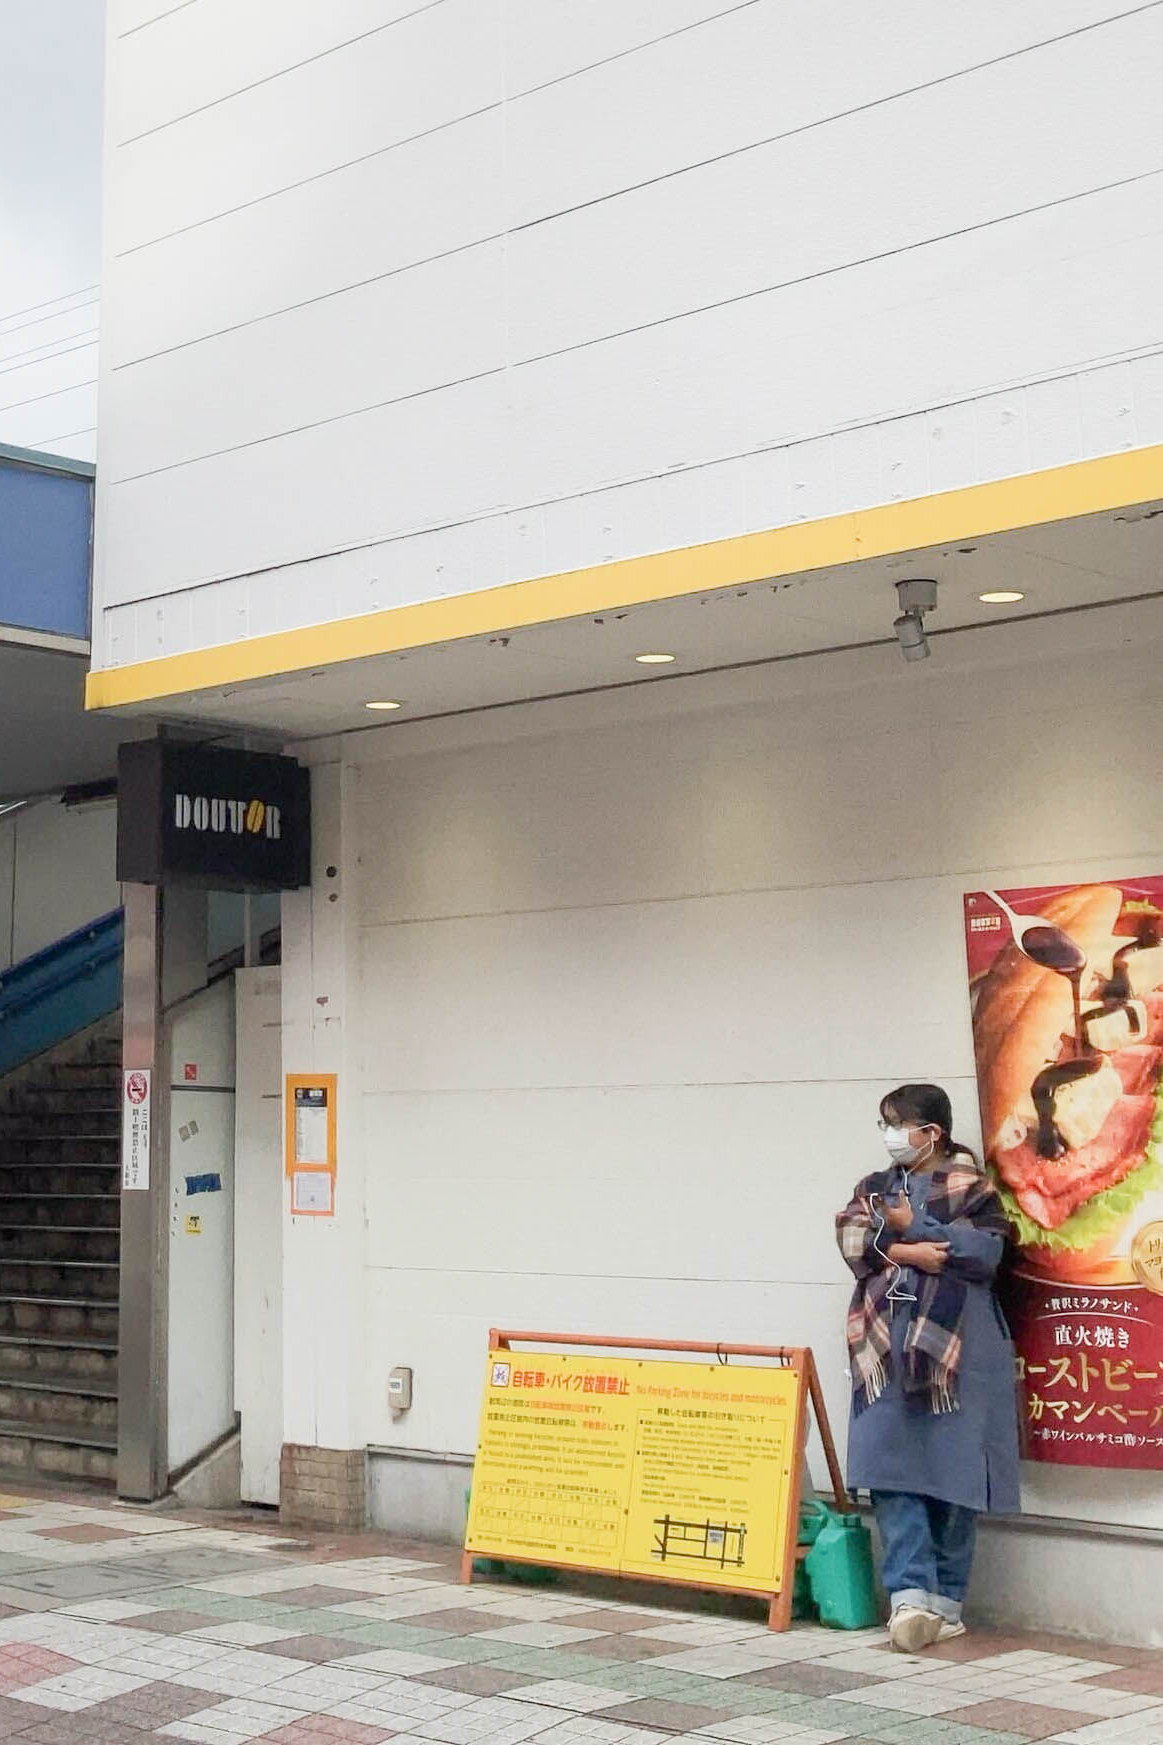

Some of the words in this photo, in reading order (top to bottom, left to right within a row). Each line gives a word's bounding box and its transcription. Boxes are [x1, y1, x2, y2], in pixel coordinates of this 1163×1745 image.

[175, 793, 281, 840] DOUTOR
[1054, 1324, 1131, 1349] 直火焼き
[1014, 1352, 1163, 1393] ーストビー
